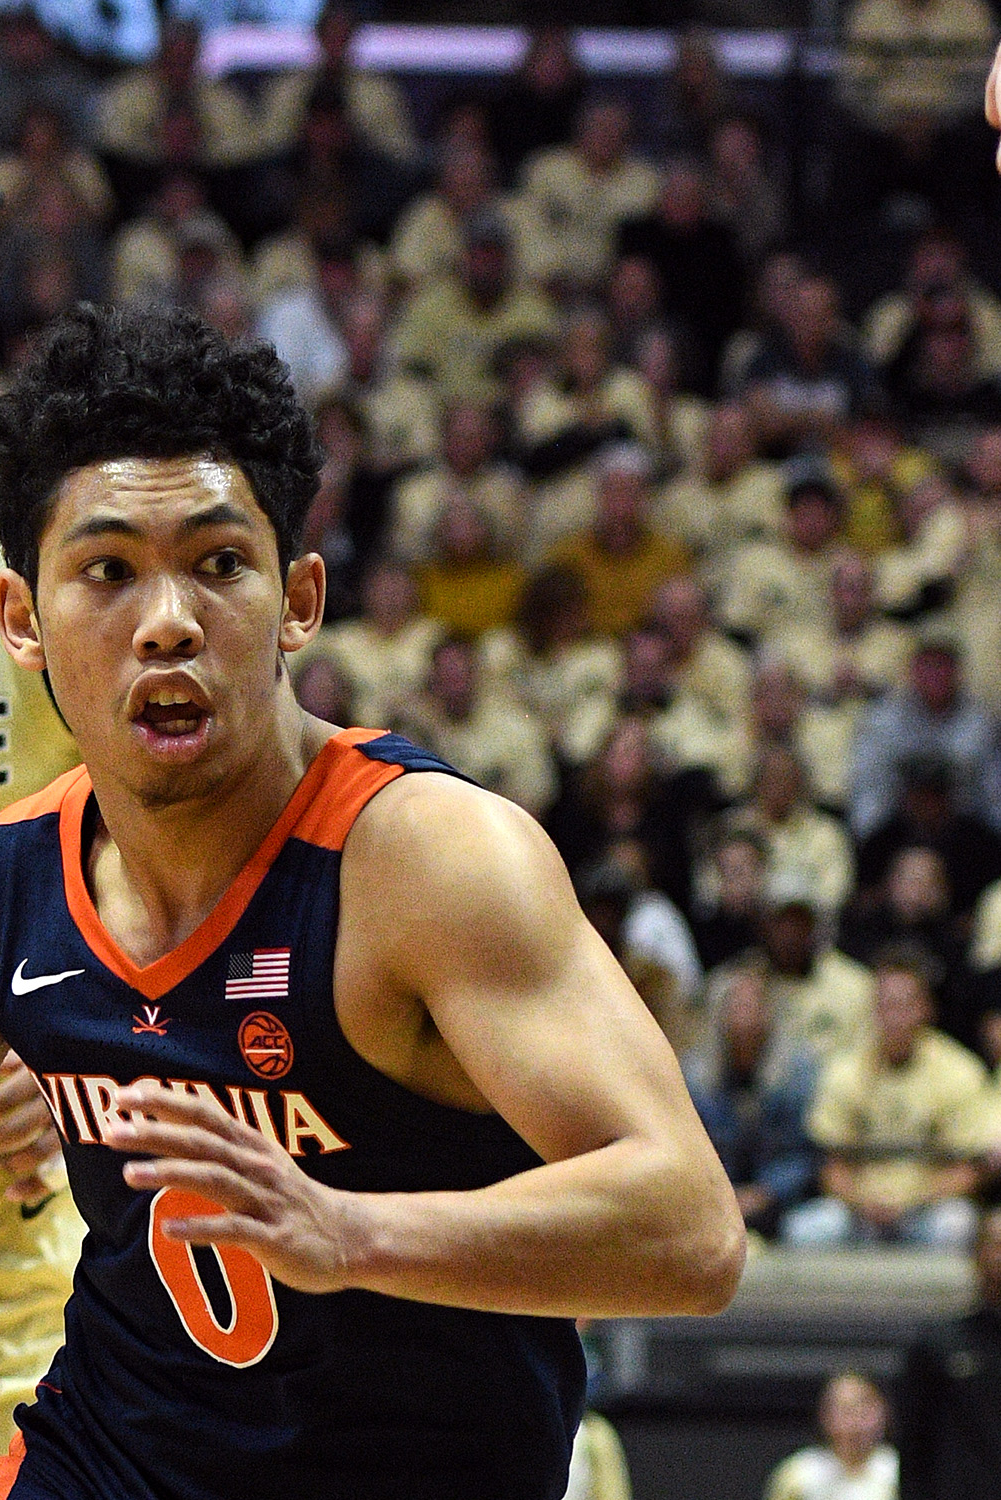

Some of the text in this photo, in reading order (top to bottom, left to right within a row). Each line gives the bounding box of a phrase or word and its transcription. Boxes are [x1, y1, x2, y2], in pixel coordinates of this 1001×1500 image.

[249, 1035, 285, 1049] ACC
[29, 1068, 352, 1158] VIRNIA
[149, 1186, 279, 1369] 0
